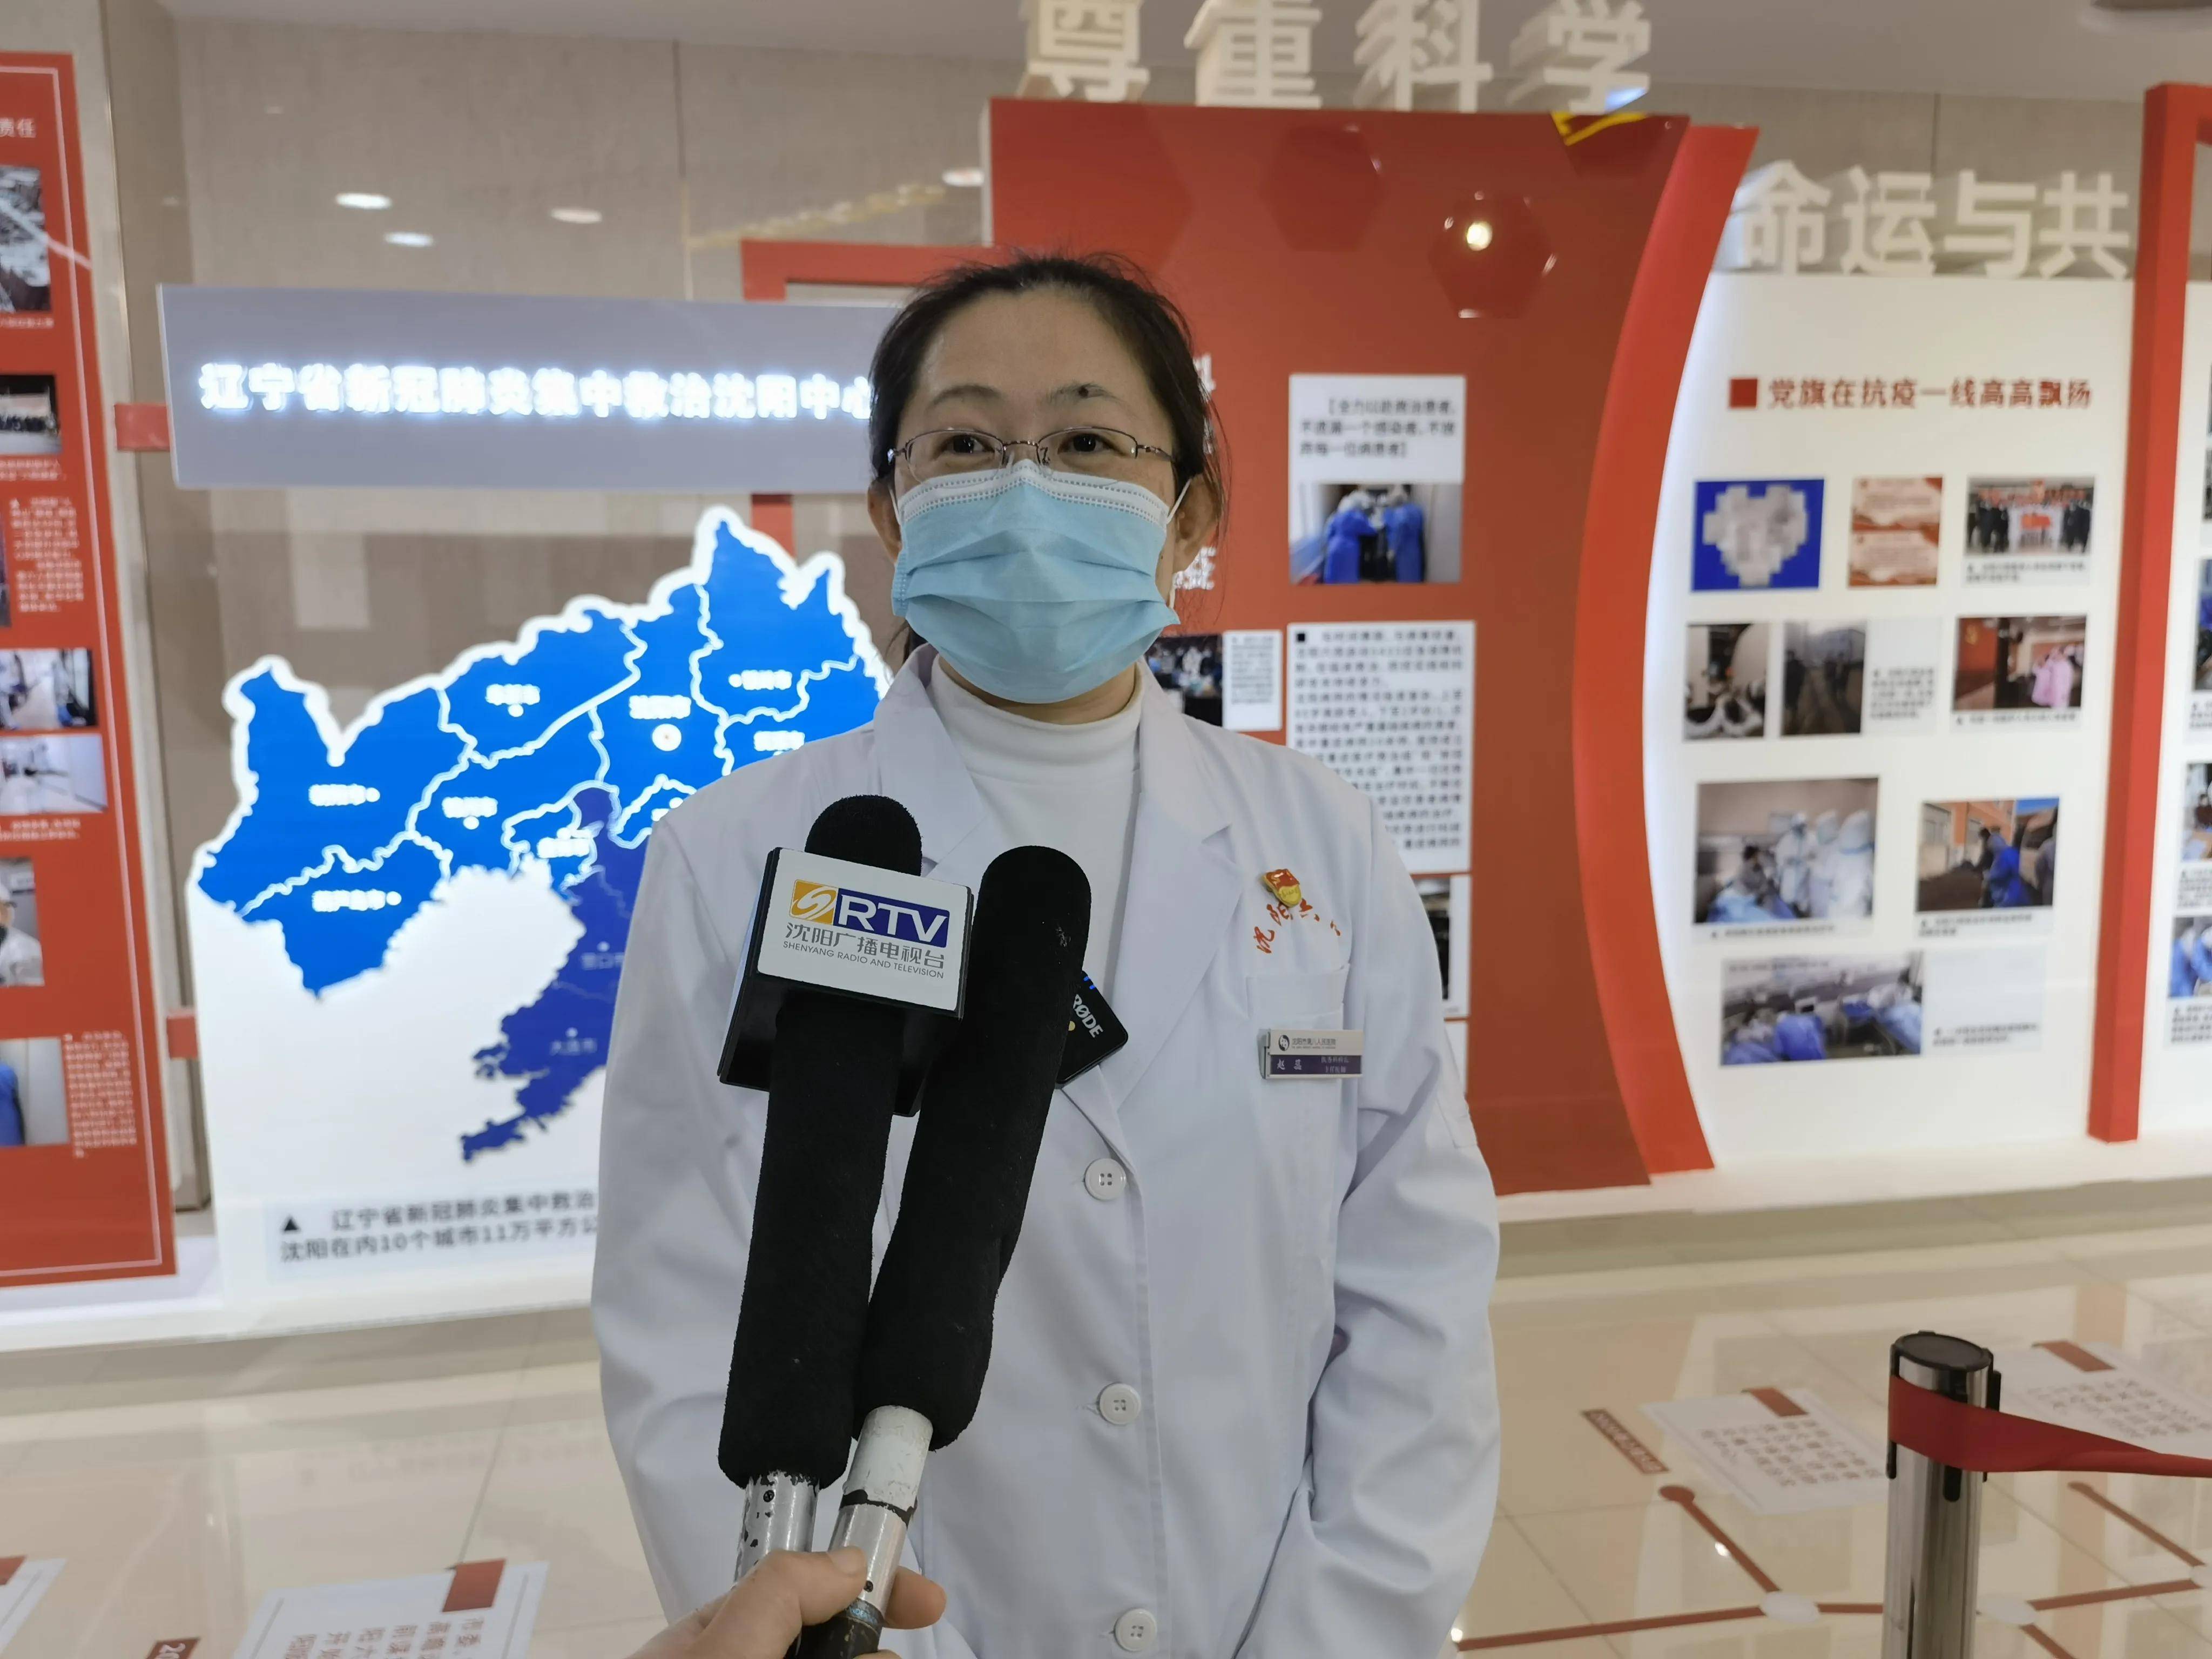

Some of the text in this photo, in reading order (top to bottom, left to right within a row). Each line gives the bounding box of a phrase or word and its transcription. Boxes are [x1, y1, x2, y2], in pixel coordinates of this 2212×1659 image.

[1022, 0, 1651, 111] 尊重科学
[1738, 159, 2130, 279] 命运与共
[1769, 378, 2092, 409] 党旗在抗疫一线高高飘扬
[783, 941, 944, 979] SHENYANG RADIO AND TELEVISION
[785, 922, 945, 969] 沈阳广播电视台
[332, 1191, 594, 1232] 辽宁省新冠肺炎集中救治
